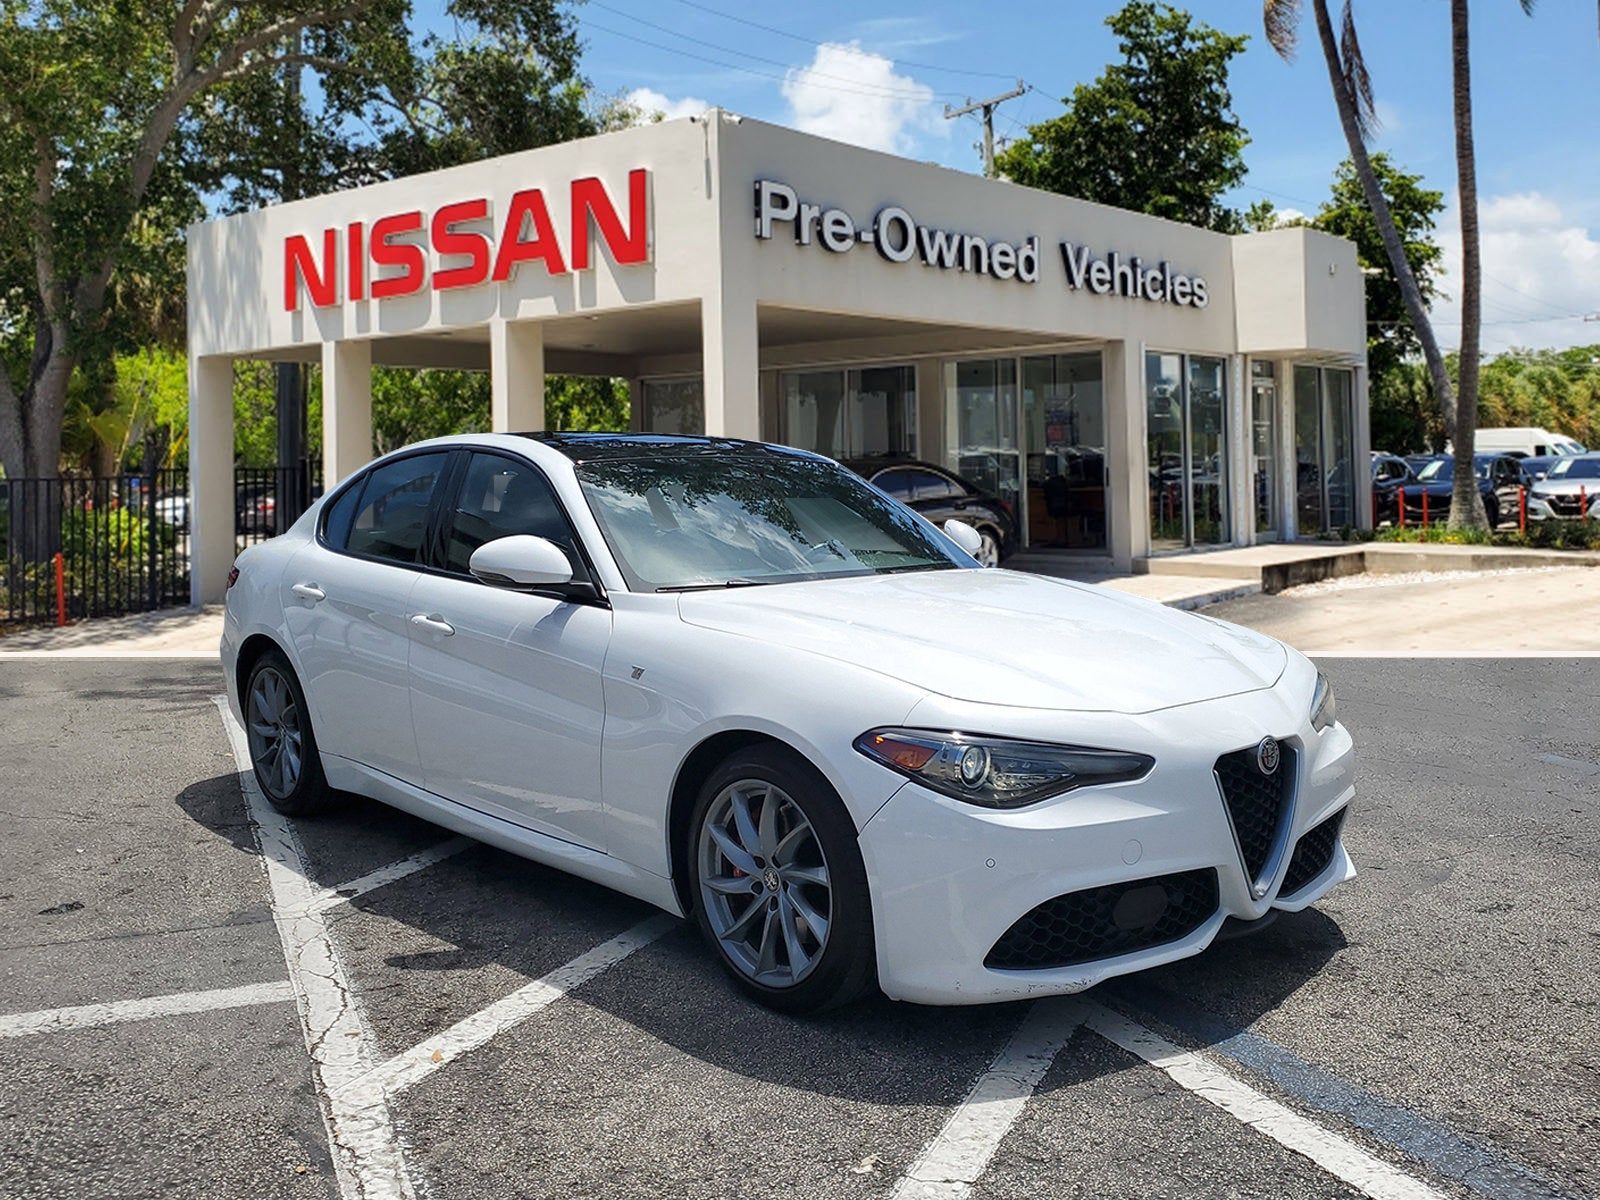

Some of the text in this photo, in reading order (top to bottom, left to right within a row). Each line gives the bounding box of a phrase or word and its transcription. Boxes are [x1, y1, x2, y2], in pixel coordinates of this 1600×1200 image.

[284, 168, 649, 311] NISSAN
[755, 180, 1209, 309] Pre-Owned Vehicles
